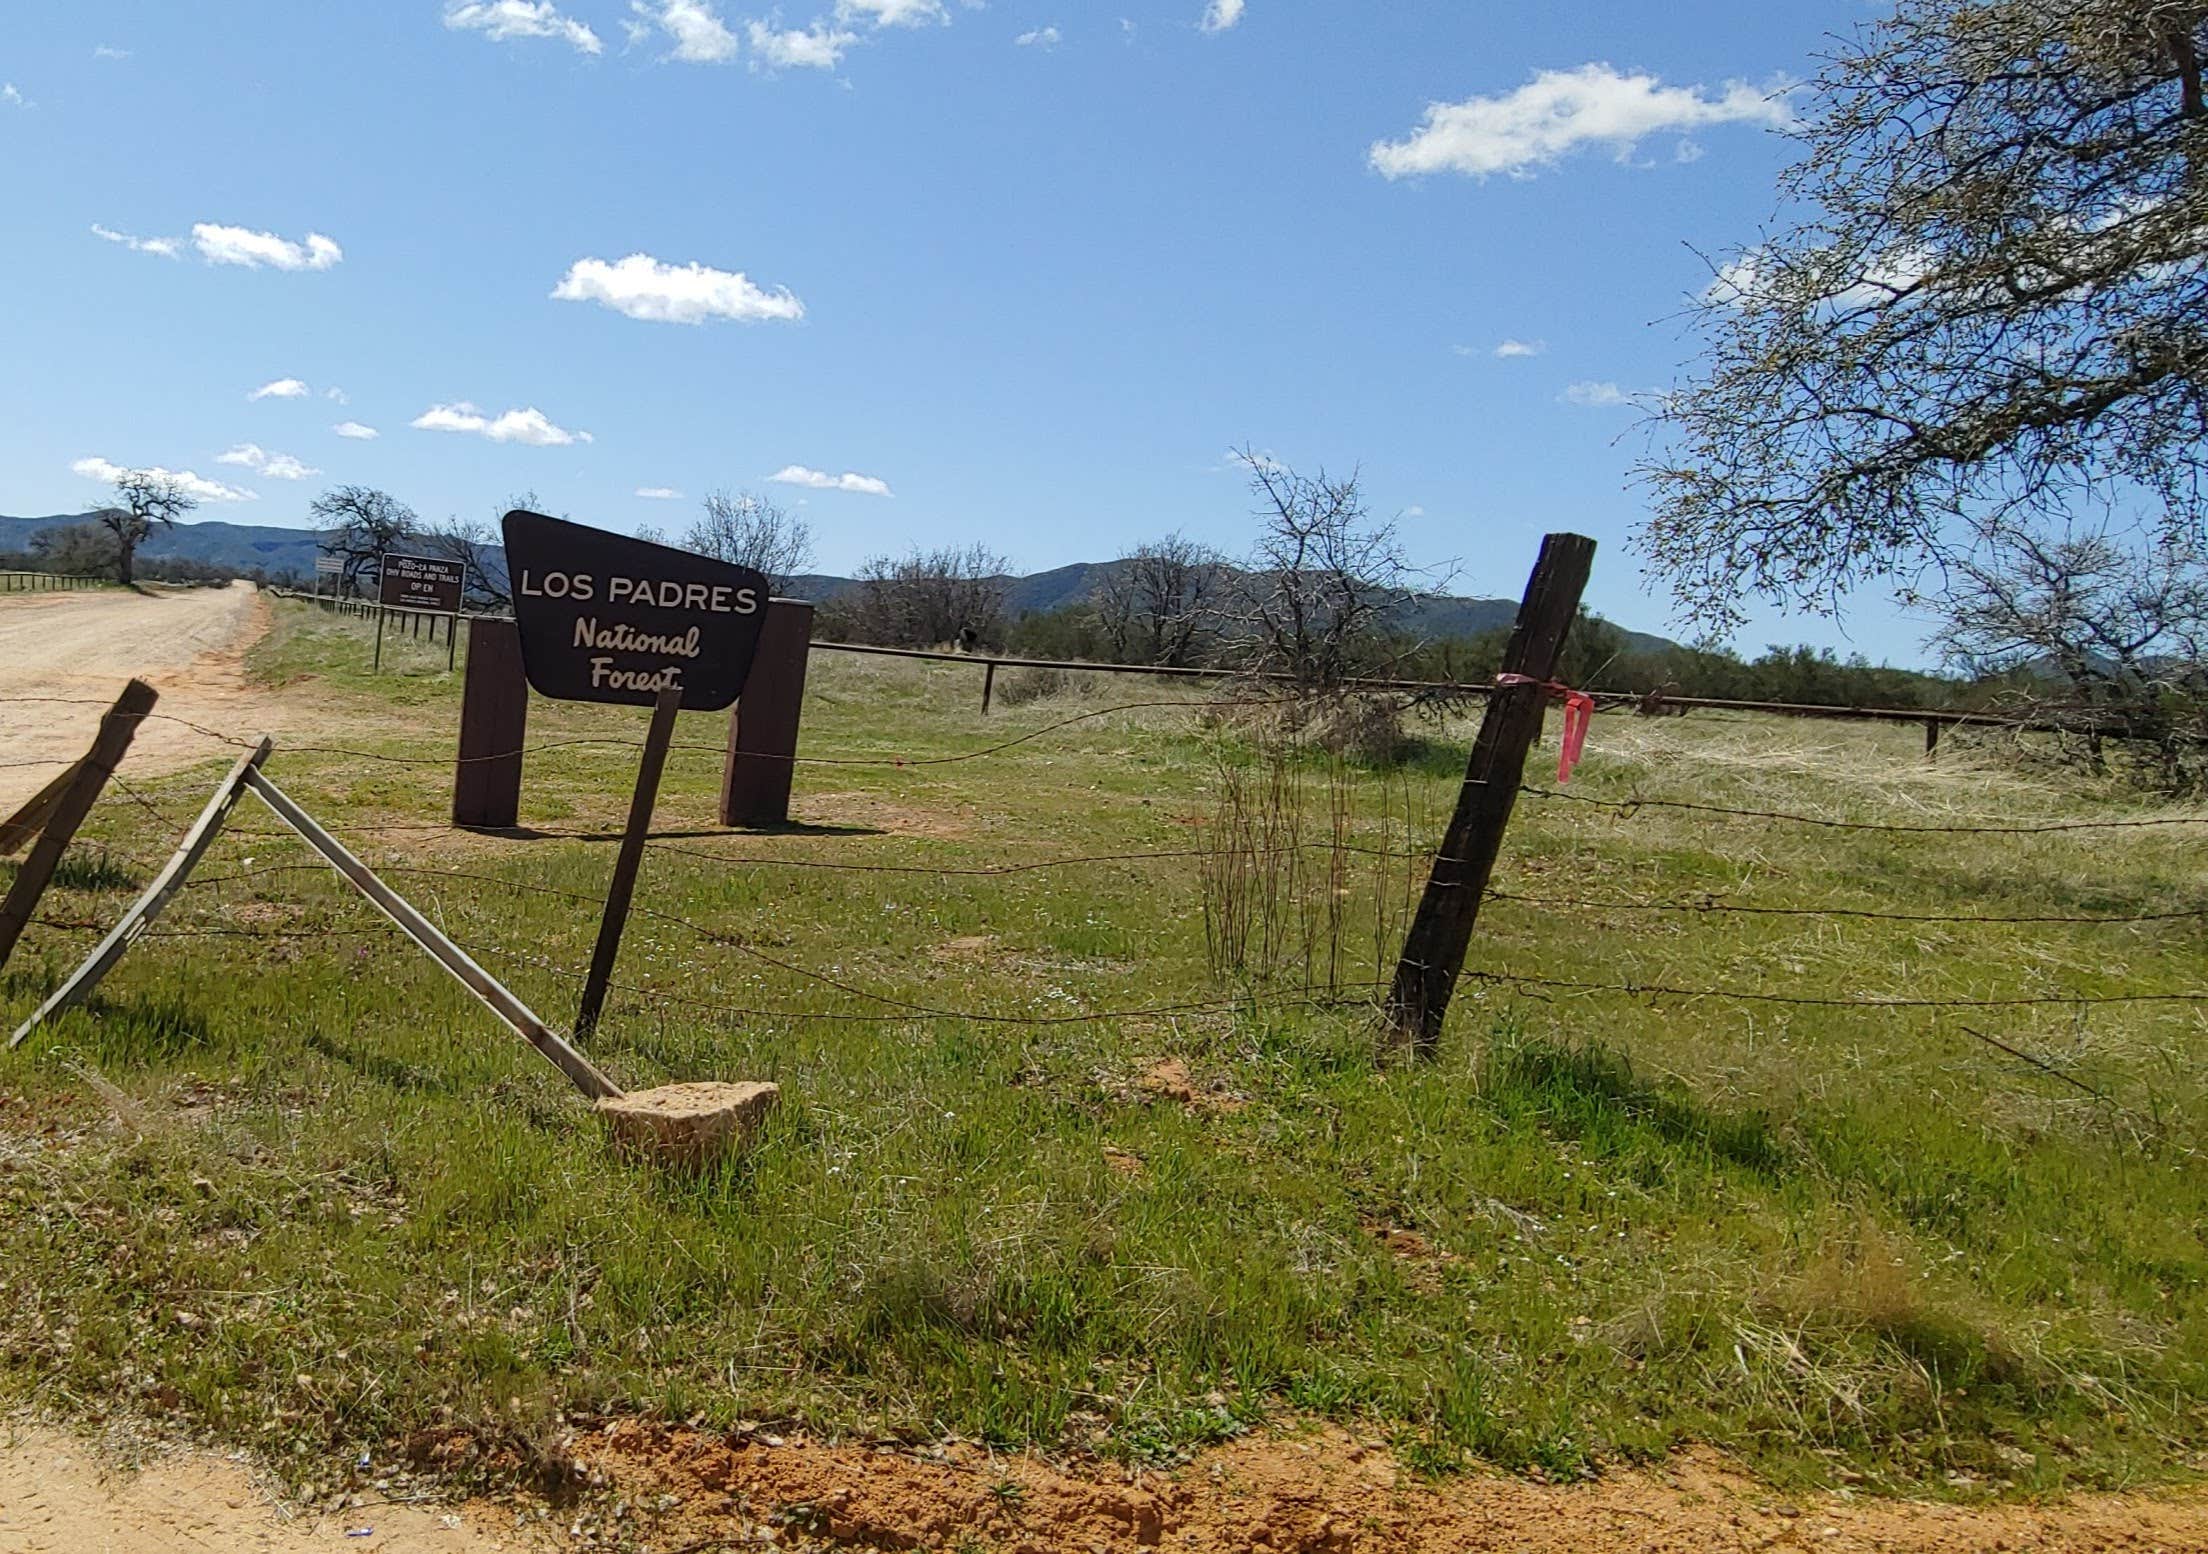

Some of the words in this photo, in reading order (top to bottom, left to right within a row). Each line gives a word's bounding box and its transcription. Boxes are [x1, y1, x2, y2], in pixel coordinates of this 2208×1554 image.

[401, 569, 422, 579] ROADS
[423, 572, 437, 581] AND
[439, 574, 460, 584] TRAILS
[520, 569, 594, 600] LOS
[609, 577, 758, 614] PADRES
[573, 617, 700, 658] National
[590, 656, 682, 692] Forest
